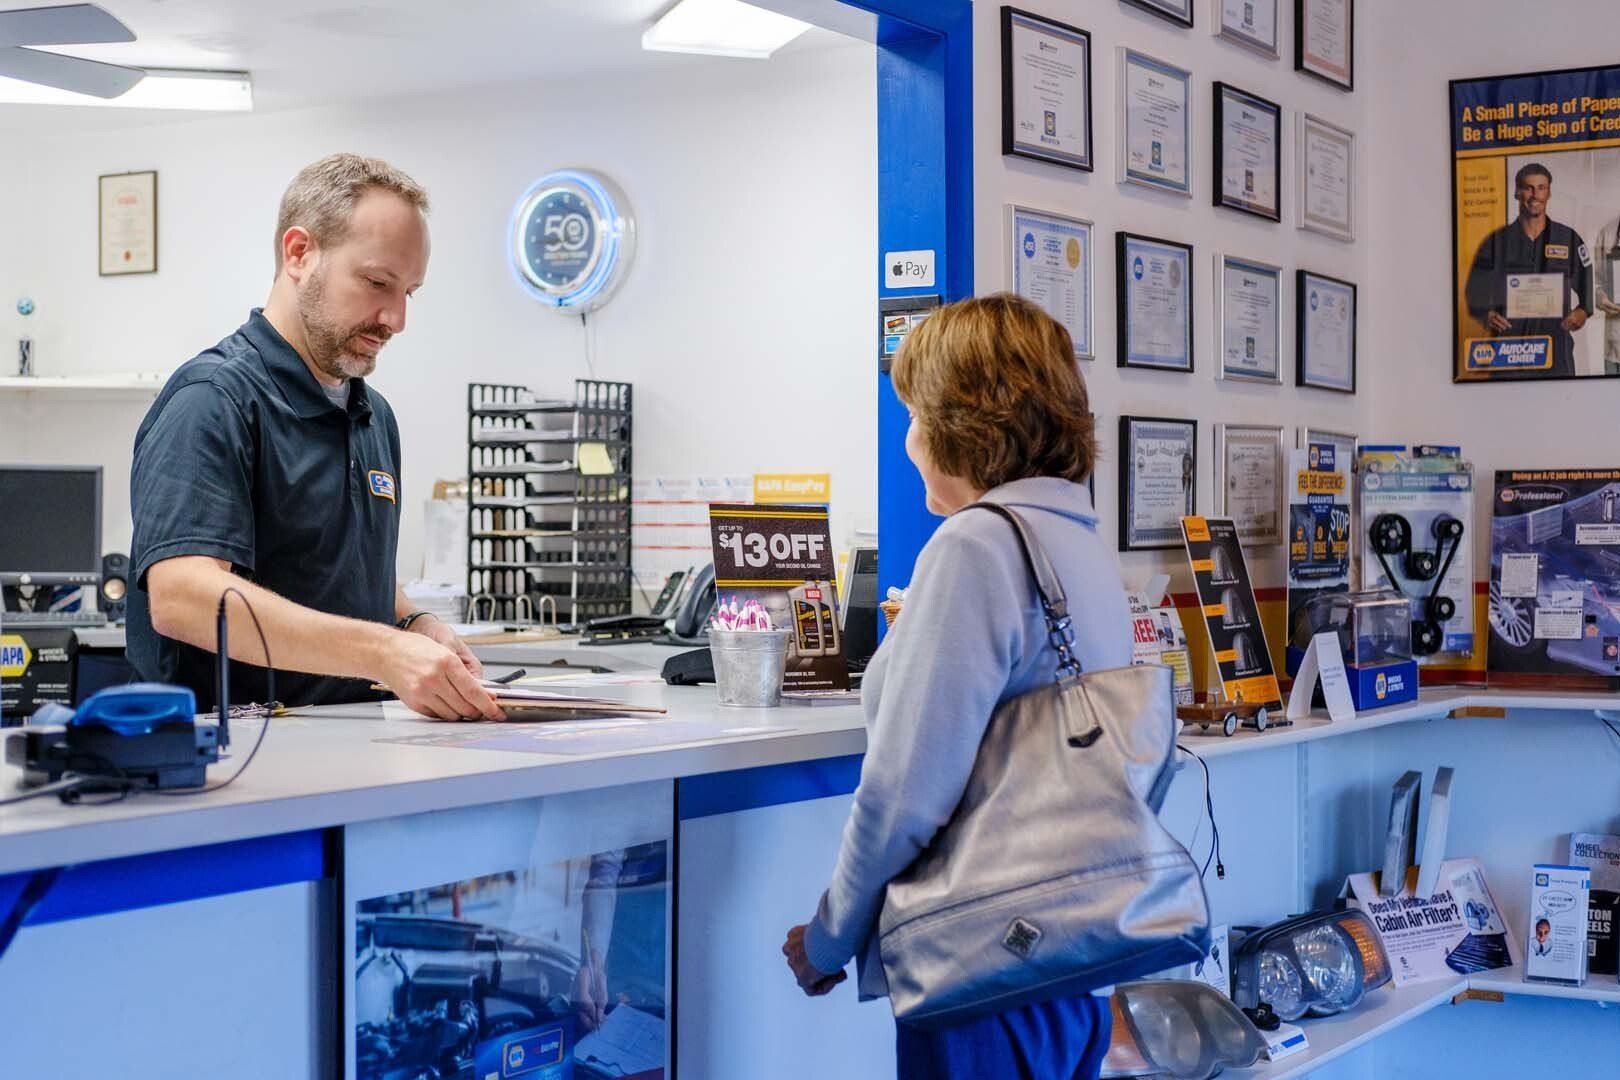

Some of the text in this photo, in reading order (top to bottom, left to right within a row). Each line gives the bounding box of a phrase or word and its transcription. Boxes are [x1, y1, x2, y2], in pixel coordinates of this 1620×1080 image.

[1463, 107, 1472, 122] A
[1476, 104, 1514, 121] Small
[1519, 102, 1558, 118] Piece
[1562, 99, 1577, 114] of
[1463, 127, 1481, 142] Be
[1485, 129, 1494, 140] a
[1498, 124, 1533, 142] Huge
[1537, 120, 1566, 138] Sign
[1571, 118, 1586, 133] of
[905, 261, 928, 279] Pay
[1475, 349, 1493, 359] NAPA
[1507, 353, 1536, 364] CENTER
[1542, 472, 1556, 480] A/C
[1556, 472, 1567, 481] job
[1568, 471, 1585, 480] right
[1514, 490, 1564, 501] Professional
[1330, 510, 1350, 533] STOP
[719, 532, 769, 567] $13
[1132, 619, 1158, 643] REE!
[1575, 842, 1600, 851] WHEEL
[1368, 901, 1388, 914] Does
[1387, 899, 1401, 912] My
[1446, 889, 1454, 902] A
[1375, 904, 1460, 933] Cabin Air Filter?
[1588, 909, 1612, 921] TOM
[1587, 921, 1612, 933] EELS
